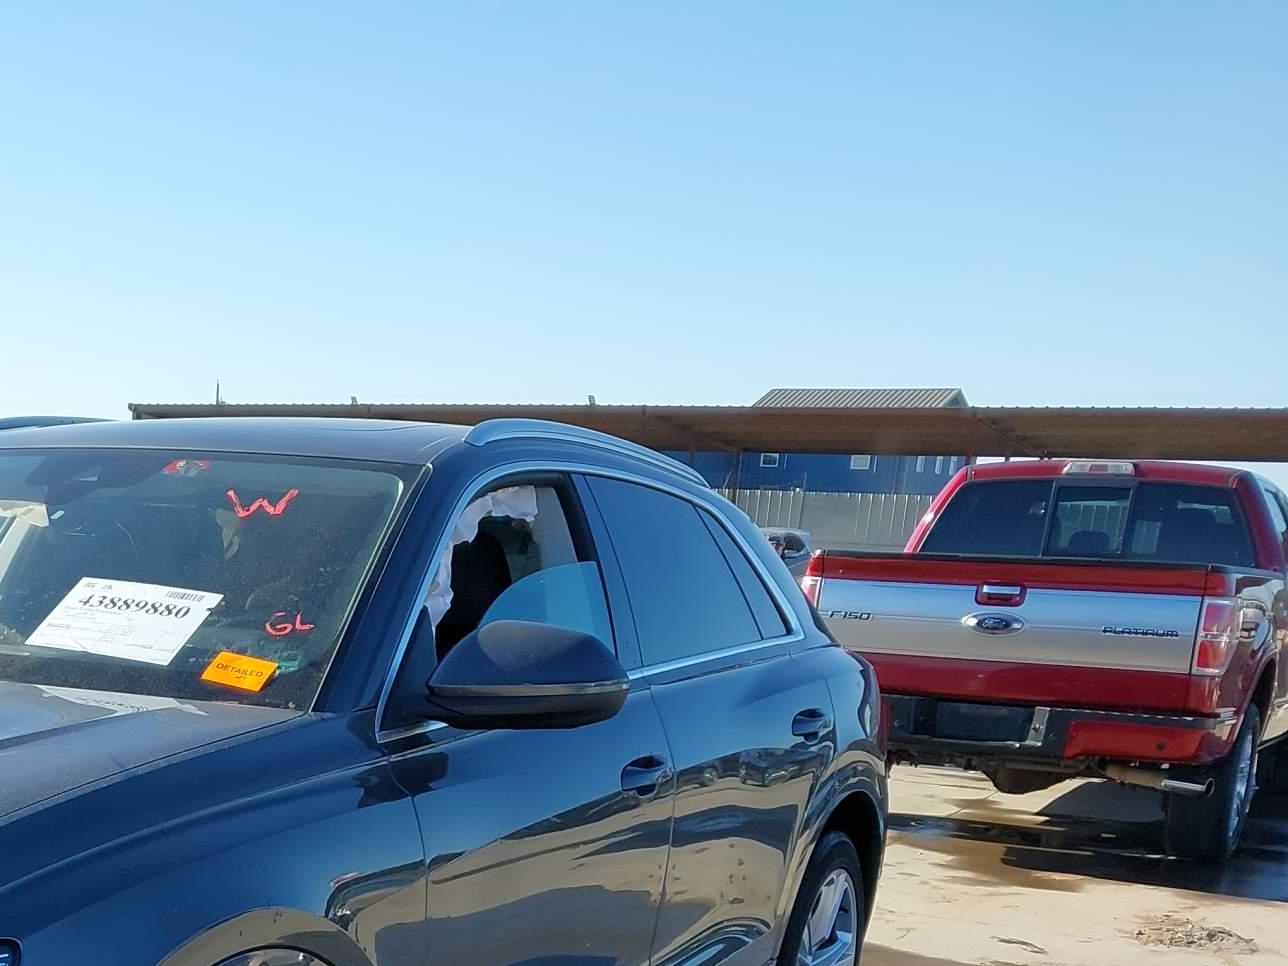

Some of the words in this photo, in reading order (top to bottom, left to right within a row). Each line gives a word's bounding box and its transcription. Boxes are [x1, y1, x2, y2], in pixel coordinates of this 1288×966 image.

[226, 487, 300, 518] W
[78, 594, 191, 619] 43889880
[1101, 626, 1180, 638] PLATINUM
[216, 662, 264, 678] DETAILED
